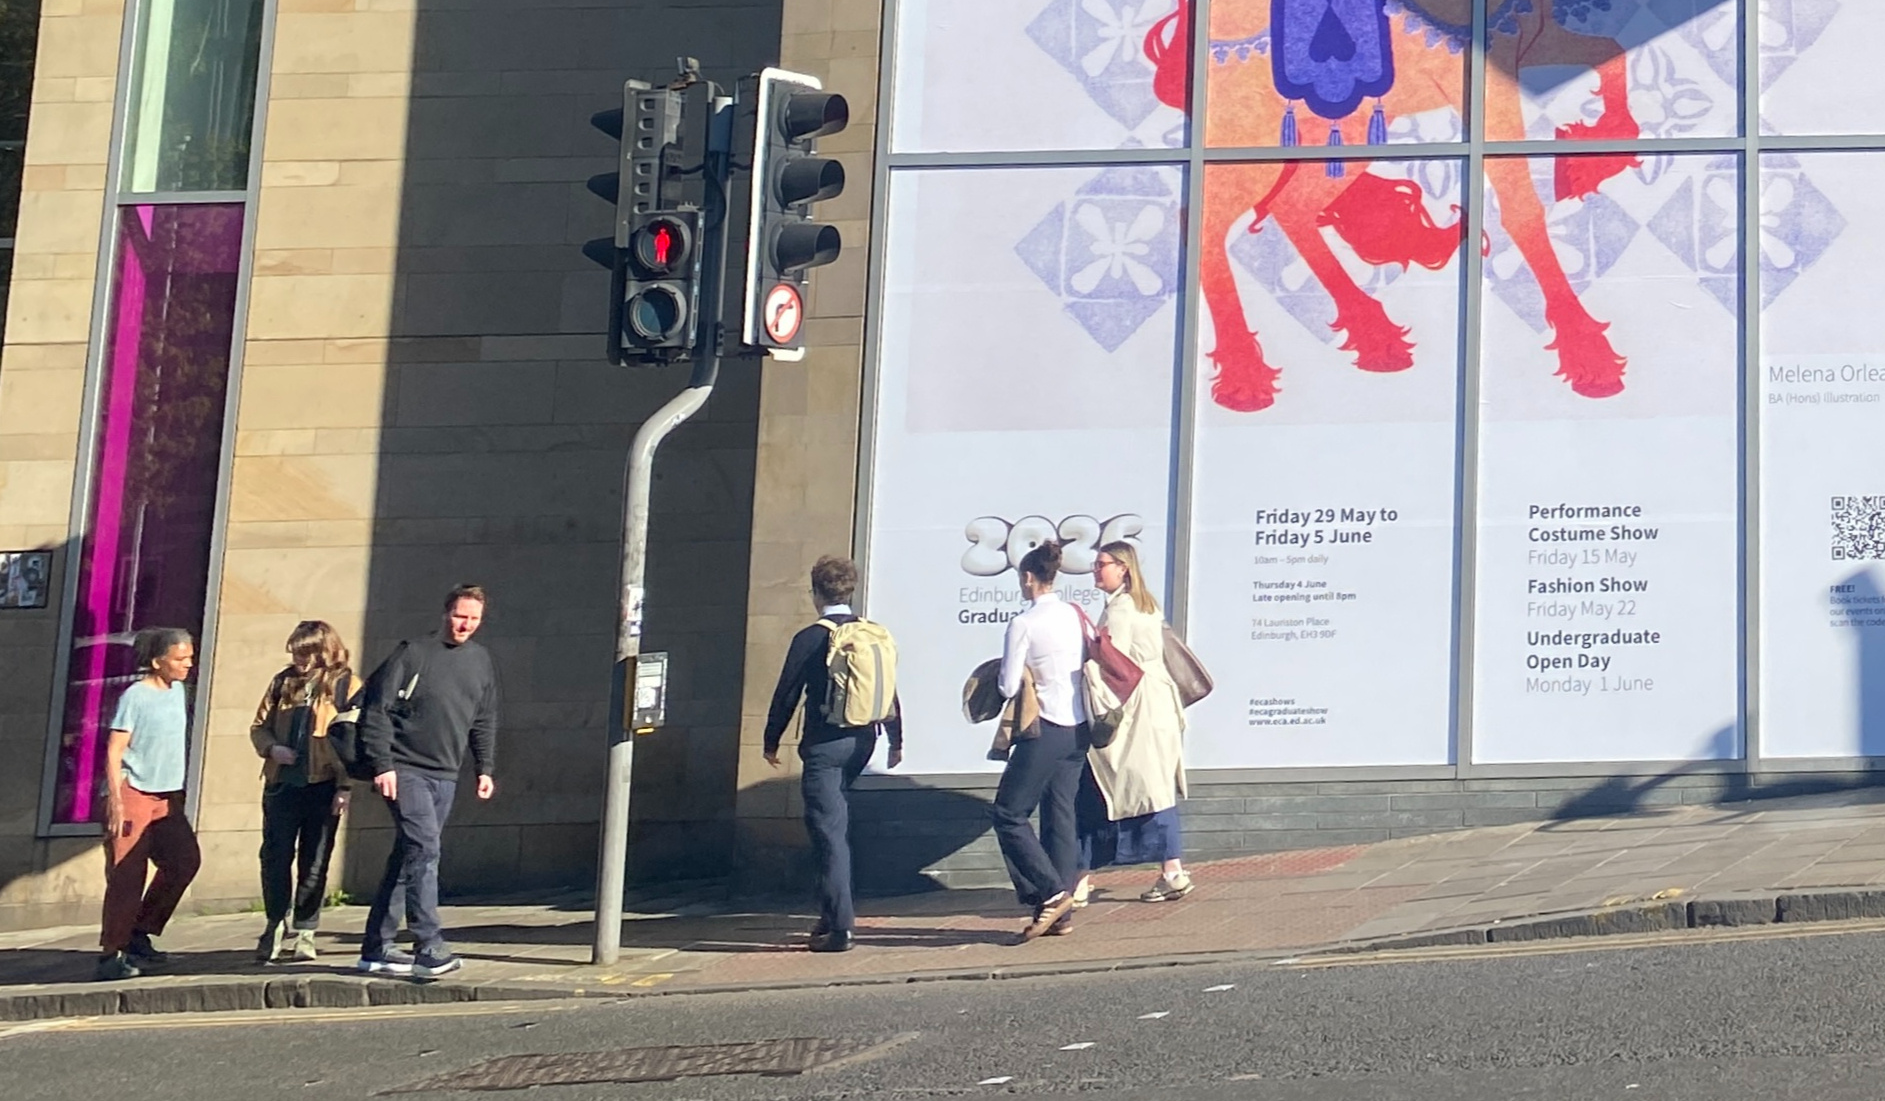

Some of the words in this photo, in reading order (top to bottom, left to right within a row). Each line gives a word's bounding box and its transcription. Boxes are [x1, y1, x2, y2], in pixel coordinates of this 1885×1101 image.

[1769, 365, 1835, 383] Melena
[1768, 393, 1784, 404] BA
[1786, 392, 1821, 406] (Hons)
[1823, 392, 1880, 404] Illustration
[1256, 508, 1311, 527] Friday
[1314, 509, 1335, 523] 29
[1340, 508, 1377, 526] May
[1380, 507, 1398, 521] to
[1529, 503, 1642, 519] Performance
[1255, 529, 1310, 548] Friday
[1314, 530, 1324, 544] 5
[1328, 529, 1372, 544] June
[1528, 527, 1606, 542] Costume
[1610, 525, 1659, 540] Show
[1254, 556, 1278, 564] 10am
[1286, 555, 1306, 566] 5pm
[1307, 554, 1329, 565] daily
[1528, 549, 1577, 569] Friday
[1582, 549, 1600, 565] 15
[1604, 548, 1637, 568] May
[1253, 581, 1296, 590] Thursday
[1304, 580, 1327, 588] June
[1528, 577, 1595, 593] Fashion
[1599, 576, 1648, 592] Show
[1830, 584, 1855, 594] FREE!
[959, 586, 1030, 607] Edinburg
[1056, 584, 1100, 605] ollege
[1253, 594, 1272, 602] Late
[1274, 593, 1311, 603] opening
[1313, 592, 1334, 600] until
[958, 608, 1025, 624] Gradua
[1527, 600, 1576, 621] Friday
[1581, 600, 1614, 620] May
[1617, 600, 1636, 615] 22
[1846, 608, 1873, 616] events
[1252, 618, 1262, 627] 74
[1264, 618, 1304, 627] Lauriston
[1306, 617, 1330, 626] Place
[1851, 618, 1864, 626] the
[1251, 630, 1299, 641] Edinburgh,
[1300, 630, 1318, 639] EH3
[1527, 629, 1661, 649] Undergraduate
[1526, 654, 1573, 673] Open
[1578, 653, 1611, 671] Day
[1526, 675, 1592, 696] Monday
[1600, 676, 1608, 691] 1
[1613, 675, 1654, 691] June
[1249, 698, 1296, 706] #ecashows
[1249, 707, 1328, 717] #ecagraduateshow
[1248, 717, 1326, 726] www.eca.ed.ac.uk
